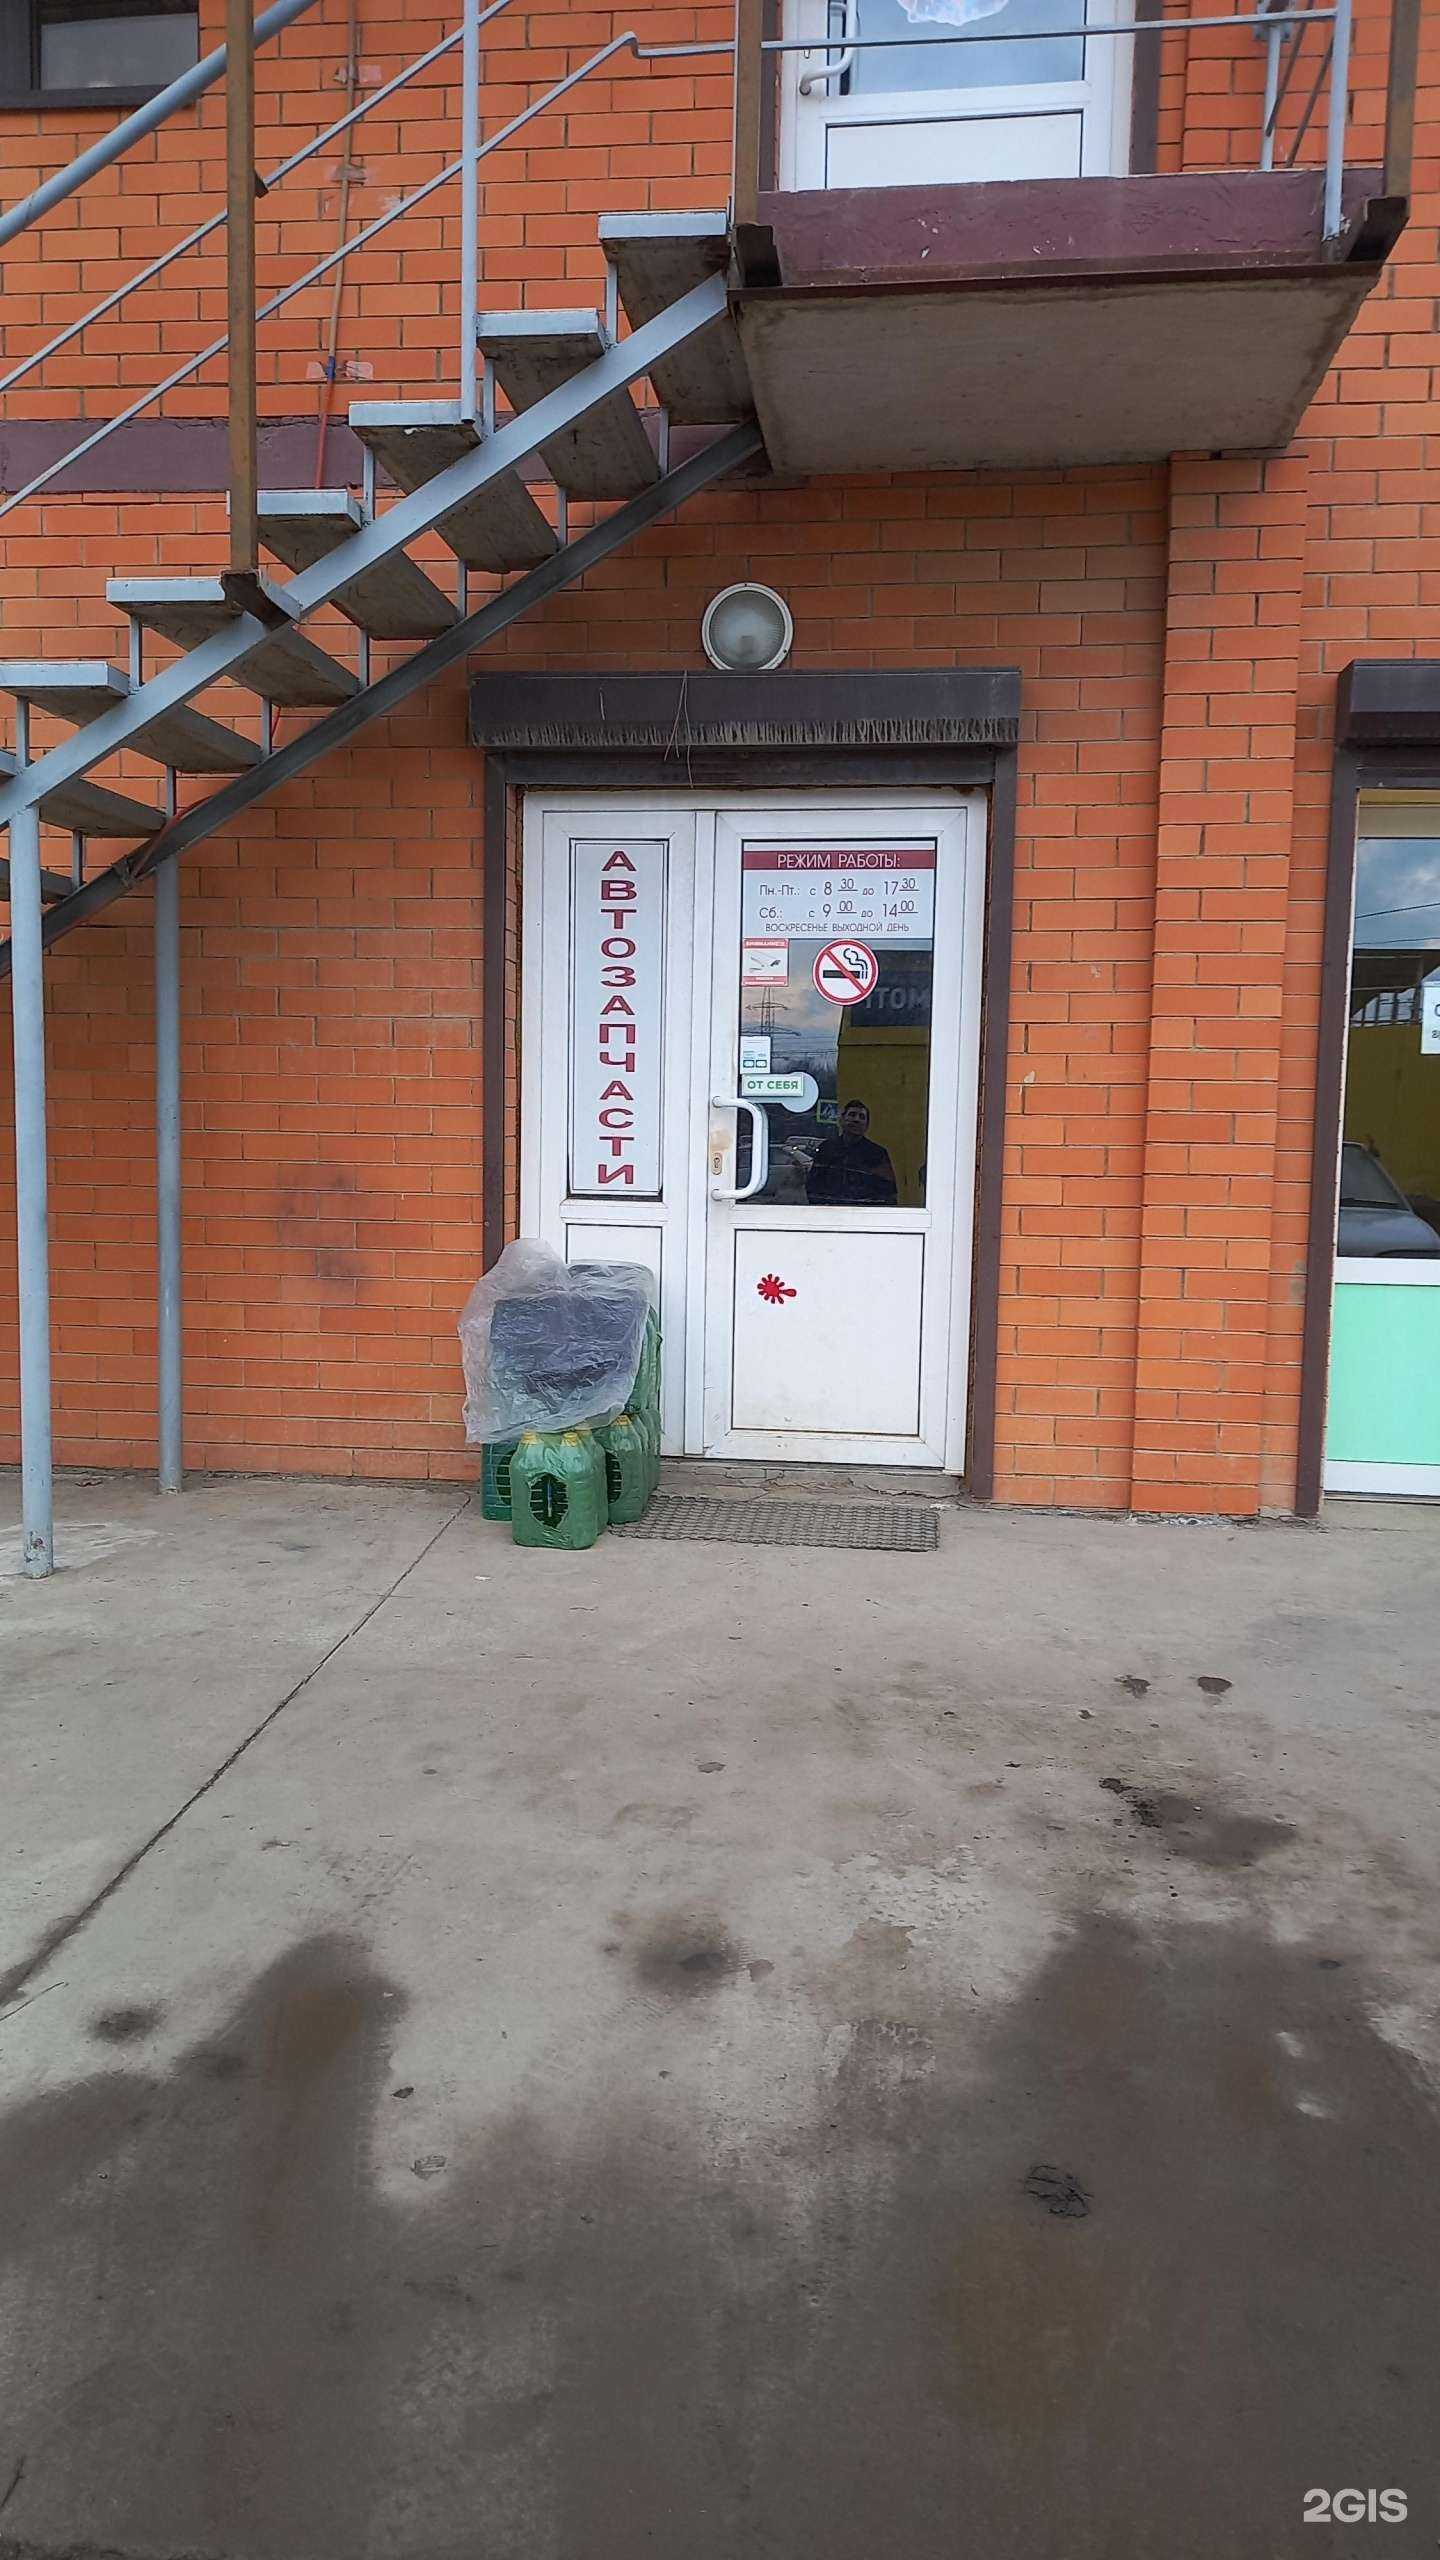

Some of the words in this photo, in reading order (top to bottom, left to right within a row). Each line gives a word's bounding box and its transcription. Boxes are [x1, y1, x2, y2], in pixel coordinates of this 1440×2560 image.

[777, 854, 831, 868] РЕЖИМ
[838, 853, 900, 868] РАБОТЫ:
[823, 881, 832, 896] 8
[759, 907, 783, 919] Сб.:
[822, 903, 832, 918] 9
[765, 923, 828, 932] ВОСКРЕСЕНЬЕ
[832, 922, 883, 932] ВЫХОДНОЙ
[886, 923, 909, 932] ДЕНЬ
[597, 849, 638, 1185] АВТОЗАПЧАСТИ
[747, 1080, 766, 1090] ОТ
[766, 1080, 799, 1090] СЕБЯ
